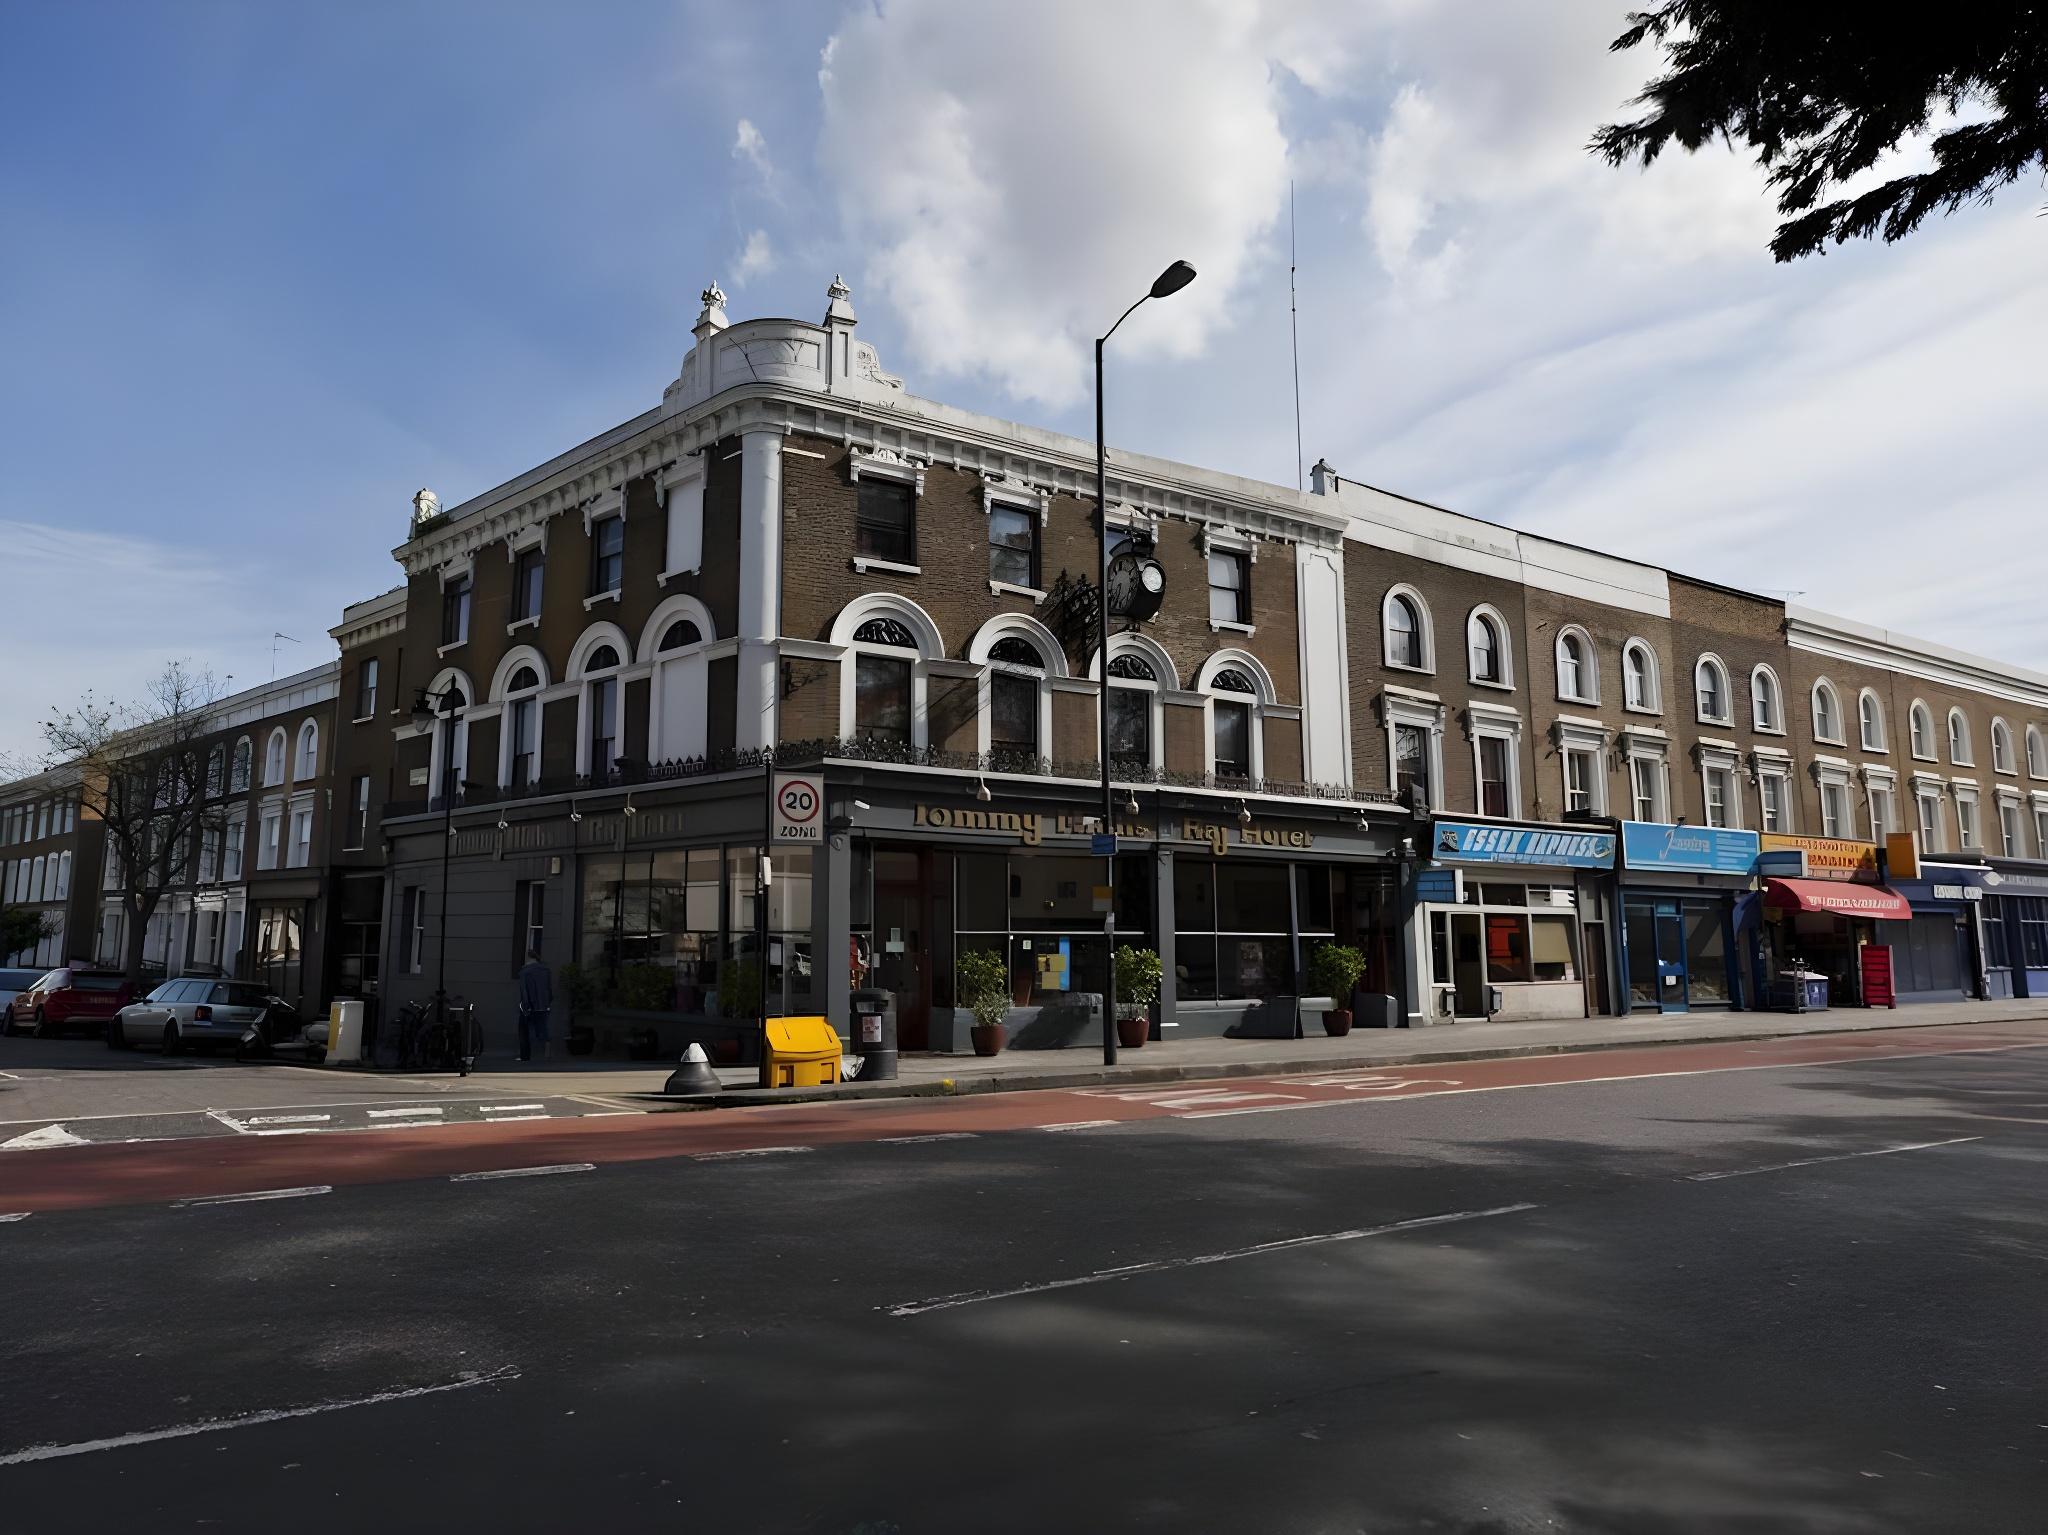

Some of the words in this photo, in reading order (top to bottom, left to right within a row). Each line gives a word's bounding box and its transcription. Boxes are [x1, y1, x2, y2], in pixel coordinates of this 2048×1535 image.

[785, 791, 812, 810] 20
[781, 826, 816, 838] ZONE
[1461, 829, 1526, 854] ESSEX
